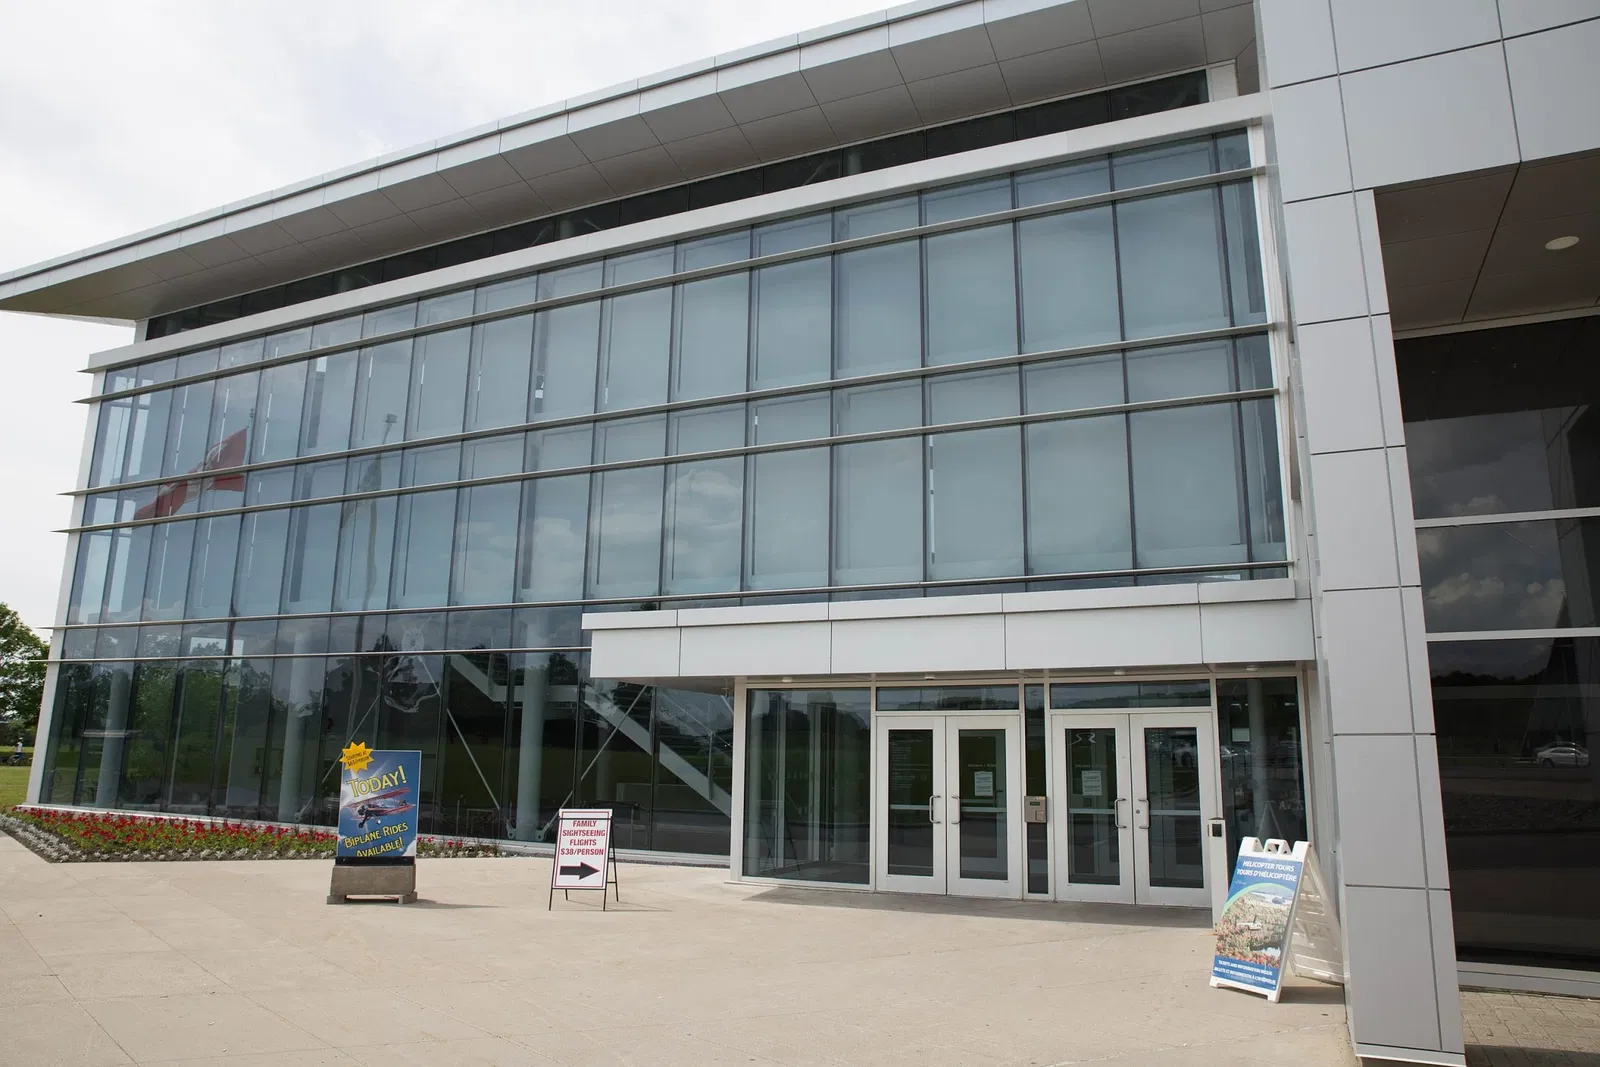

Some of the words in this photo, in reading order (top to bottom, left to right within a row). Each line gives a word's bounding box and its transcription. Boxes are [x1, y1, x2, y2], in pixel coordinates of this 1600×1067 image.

[346, 765, 407, 797] TODAY!
[344, 830, 382, 849] BIPLANE
[382, 822, 409, 837] RIDES
[356, 836, 404, 857] AVAILABLE!
[560, 848, 604, 856] $38/PERSON
[1236, 868, 1253, 876] TOURS
[1242, 860, 1275, 870] HELICOPTER
[1275, 863, 1295, 872] TOURS
